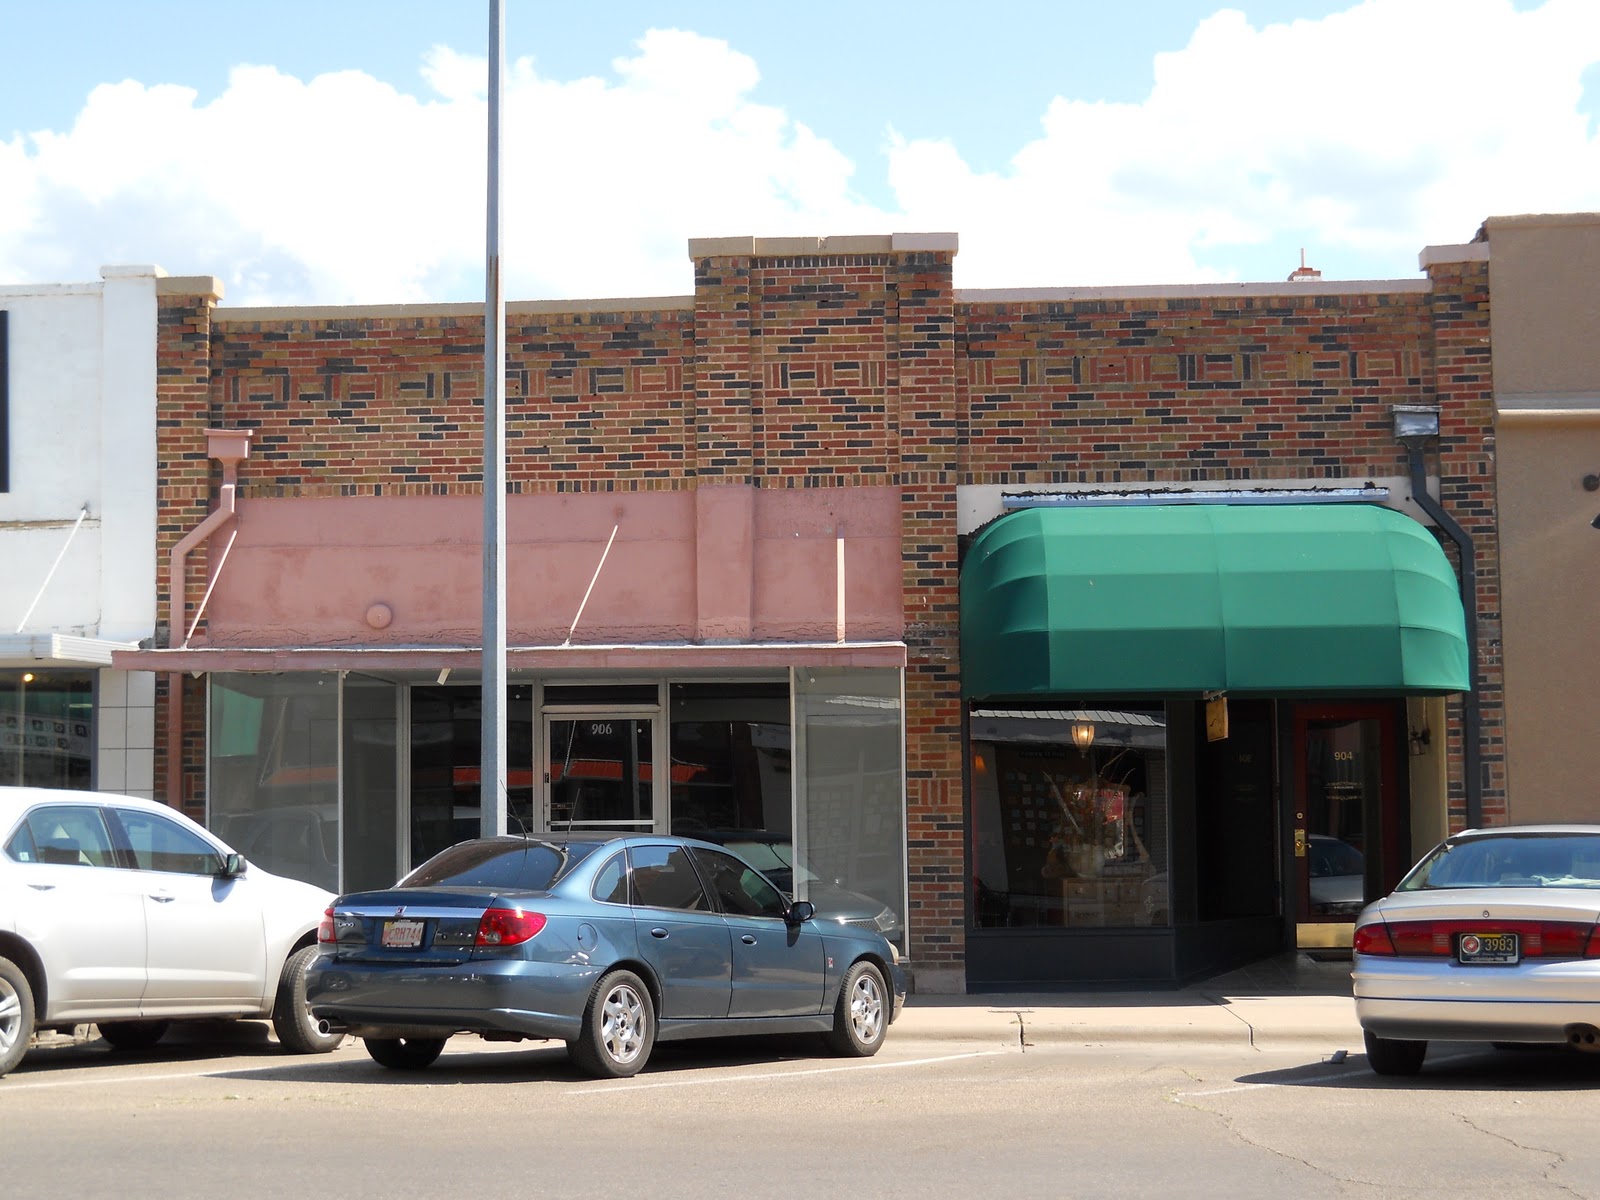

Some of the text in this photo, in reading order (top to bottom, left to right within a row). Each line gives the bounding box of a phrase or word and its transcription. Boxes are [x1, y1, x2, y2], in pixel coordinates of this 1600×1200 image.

[592, 723, 613, 735] 906
[1334, 751, 1353, 761] 904
[1485, 938, 1513, 951] 3983
